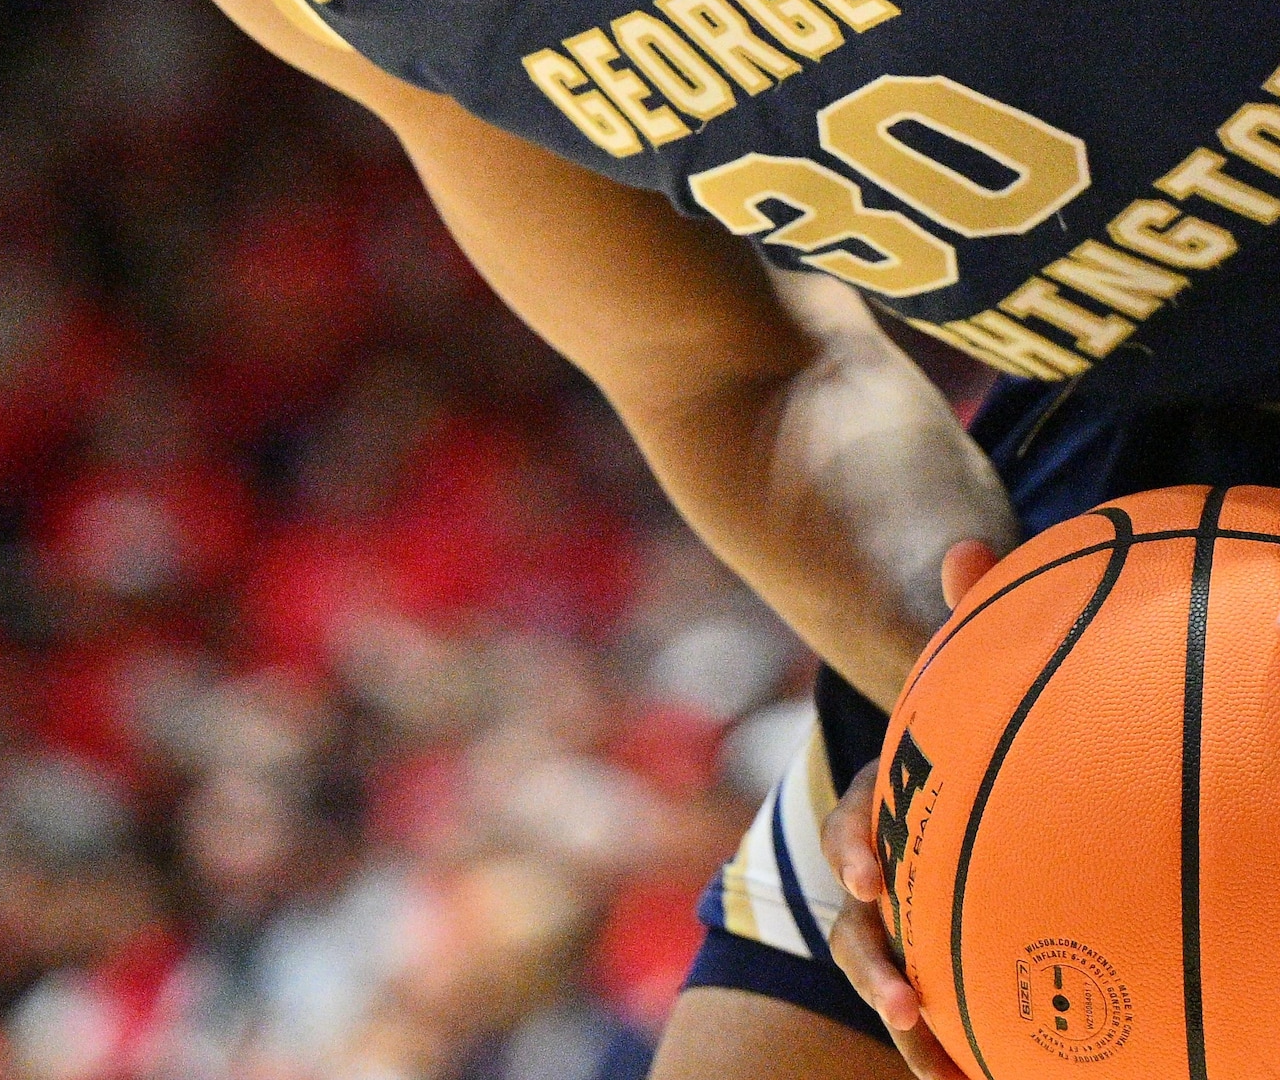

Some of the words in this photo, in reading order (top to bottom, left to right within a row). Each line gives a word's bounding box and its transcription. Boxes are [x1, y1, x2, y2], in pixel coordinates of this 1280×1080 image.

[687, 73, 1092, 299] 30
[906, 860, 919, 948] GAME
[913, 780, 944, 857] BALL
[1019, 964, 1029, 974] 7
[1024, 938, 1117, 977] WILSON.COM/PATENTS
[1032, 950, 1067, 964] INFLATE
[1088, 964, 1105, 979] PSI
[1020, 981, 1031, 1016] SIZE
[1106, 986, 1122, 1027] GONFLER
[1117, 984, 1133, 1010] MADE
[1124, 1013, 1134, 1022] IN
[1095, 1028, 1117, 1048] ENTRE
[1115, 1024, 1132, 1047] CHINA
